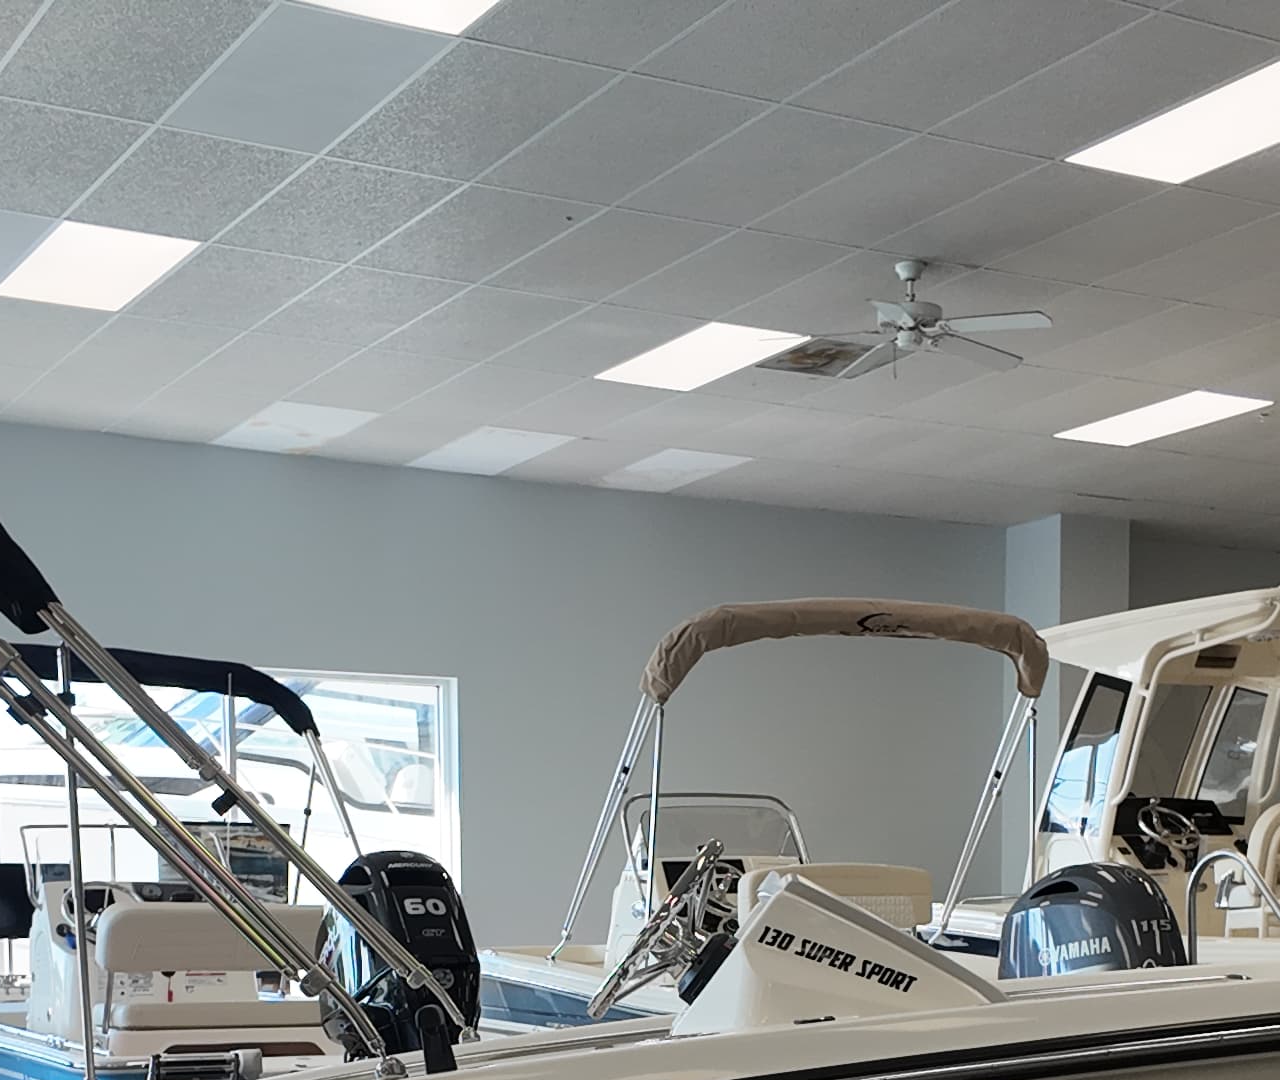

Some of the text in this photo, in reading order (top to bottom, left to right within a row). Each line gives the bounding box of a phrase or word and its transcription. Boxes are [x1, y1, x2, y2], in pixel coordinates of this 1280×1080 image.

[404, 898, 446, 915] 60
[1140, 920, 1171, 931] 115
[758, 926, 917, 992] 130 SUPER SPORT
[1051, 937, 1111, 965] YAMAHA
